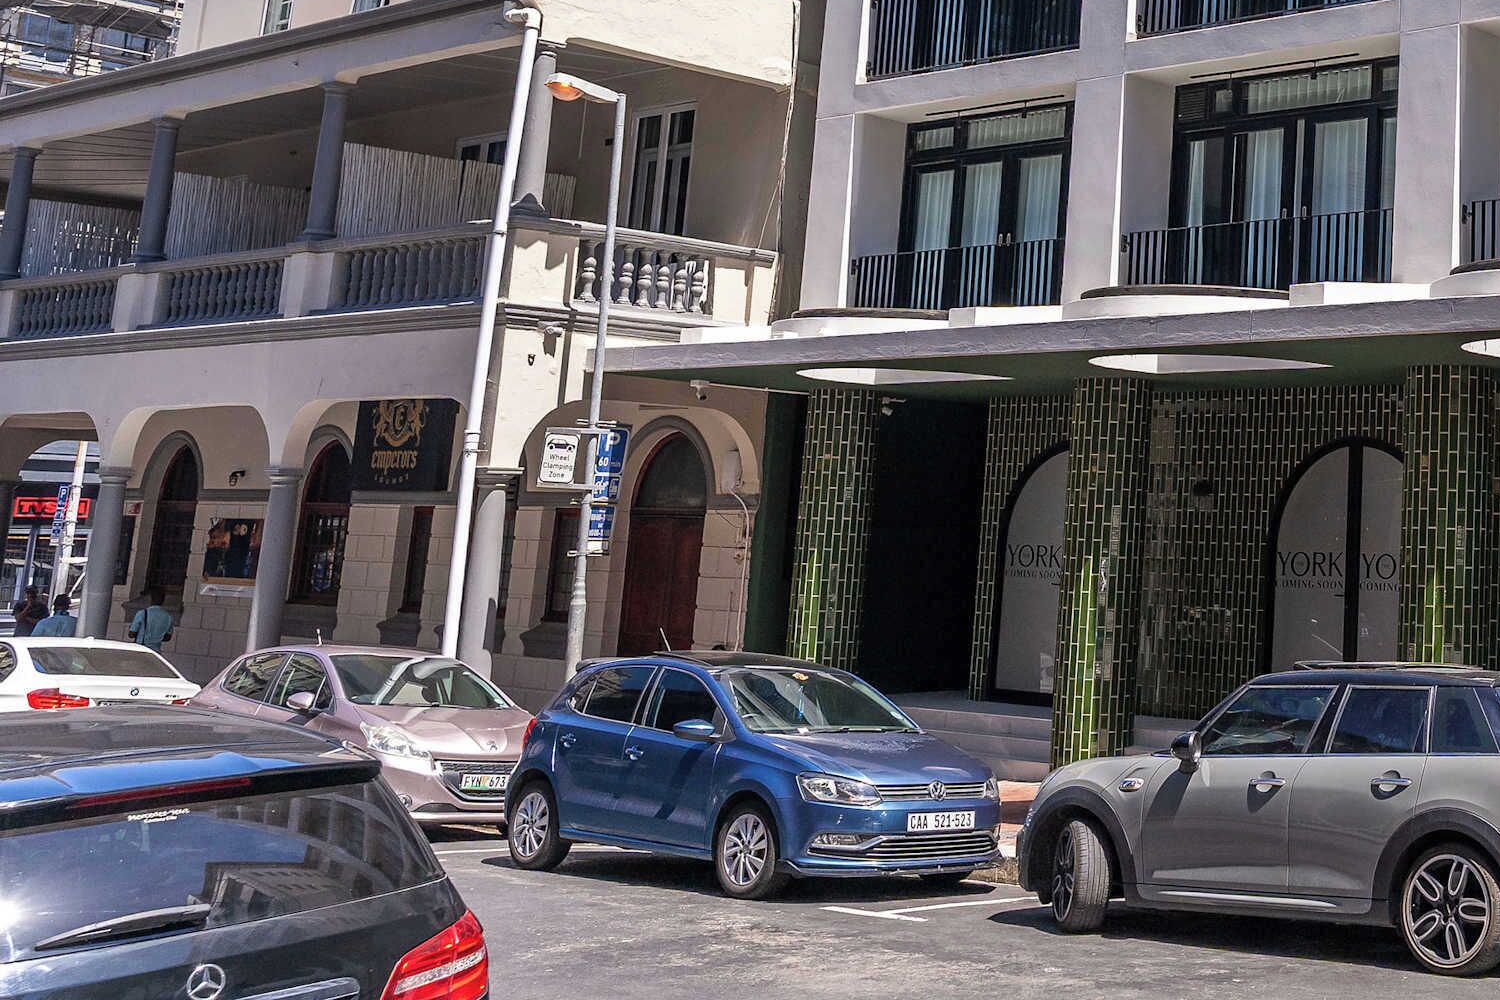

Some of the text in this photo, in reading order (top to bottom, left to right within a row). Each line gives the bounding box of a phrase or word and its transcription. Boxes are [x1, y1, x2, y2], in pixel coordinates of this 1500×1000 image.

[604, 432, 621, 452] P
[371, 450, 418, 475] emperors
[549, 454, 570, 462] Wheel
[598, 457, 609, 467] 60
[543, 462, 573, 471] Clamping
[1007, 544, 1062, 568] YORK
[1277, 551, 1344, 577] YORK
[1278, 579, 1344, 590] OMING SOON
[464, 775, 506, 788] FYN 673
[910, 813, 972, 829] CAA 521-523
